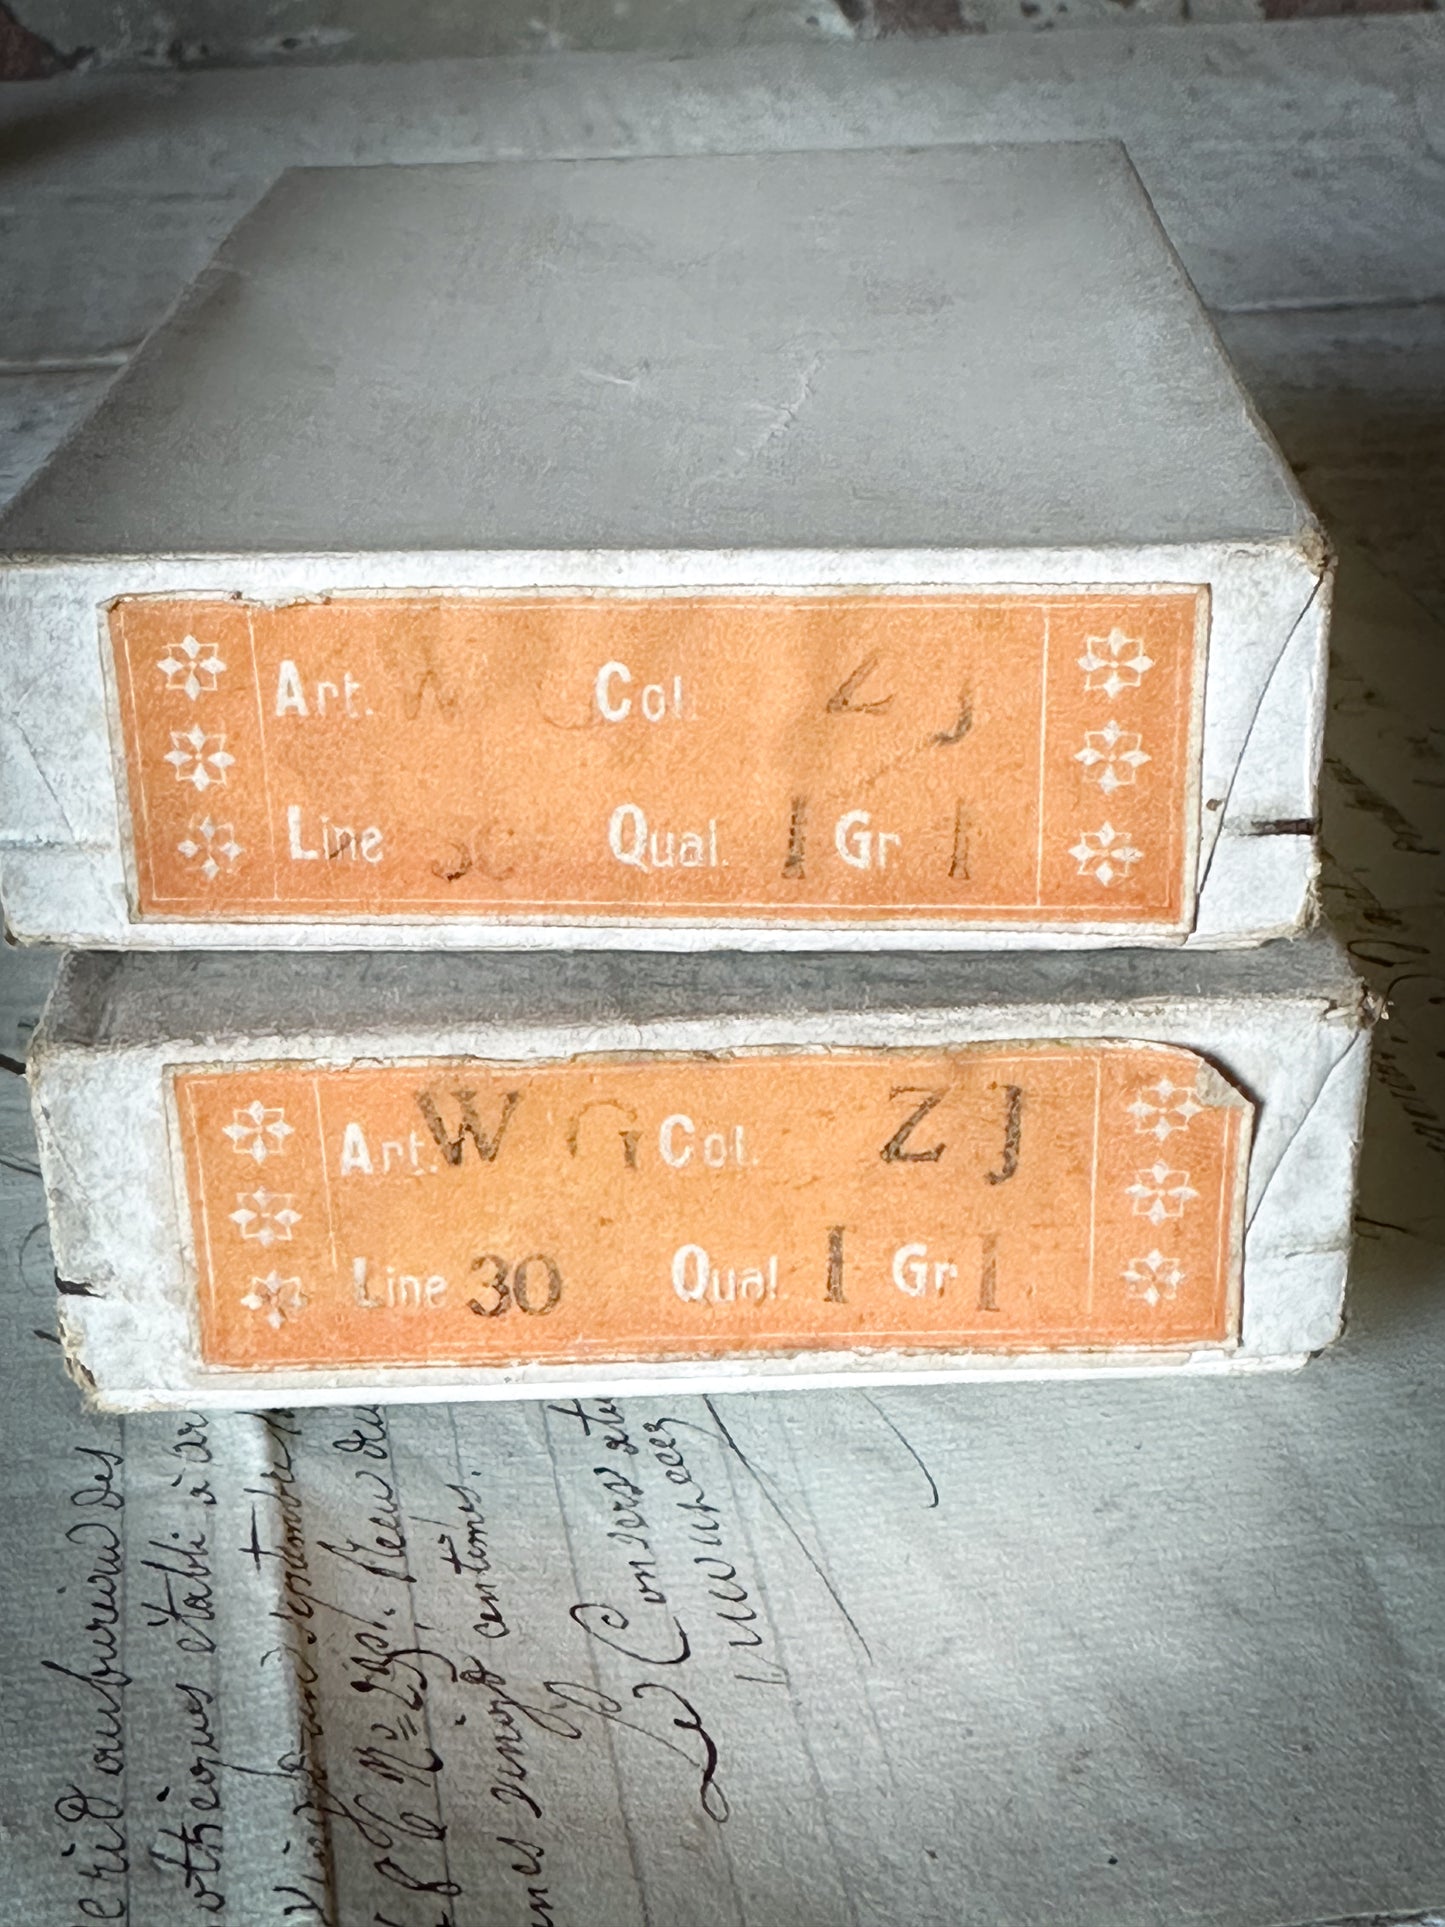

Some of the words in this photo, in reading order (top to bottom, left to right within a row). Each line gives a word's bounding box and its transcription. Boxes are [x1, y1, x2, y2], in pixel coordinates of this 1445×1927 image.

[276, 660, 374, 717] Art.
[288, 805, 384, 863] Line
[341, 1122, 438, 1176] Art.
[880, 1086, 949, 1164] Z
[353, 1256, 447, 1309] Line
[464, 1253, 563, 1319] 30
